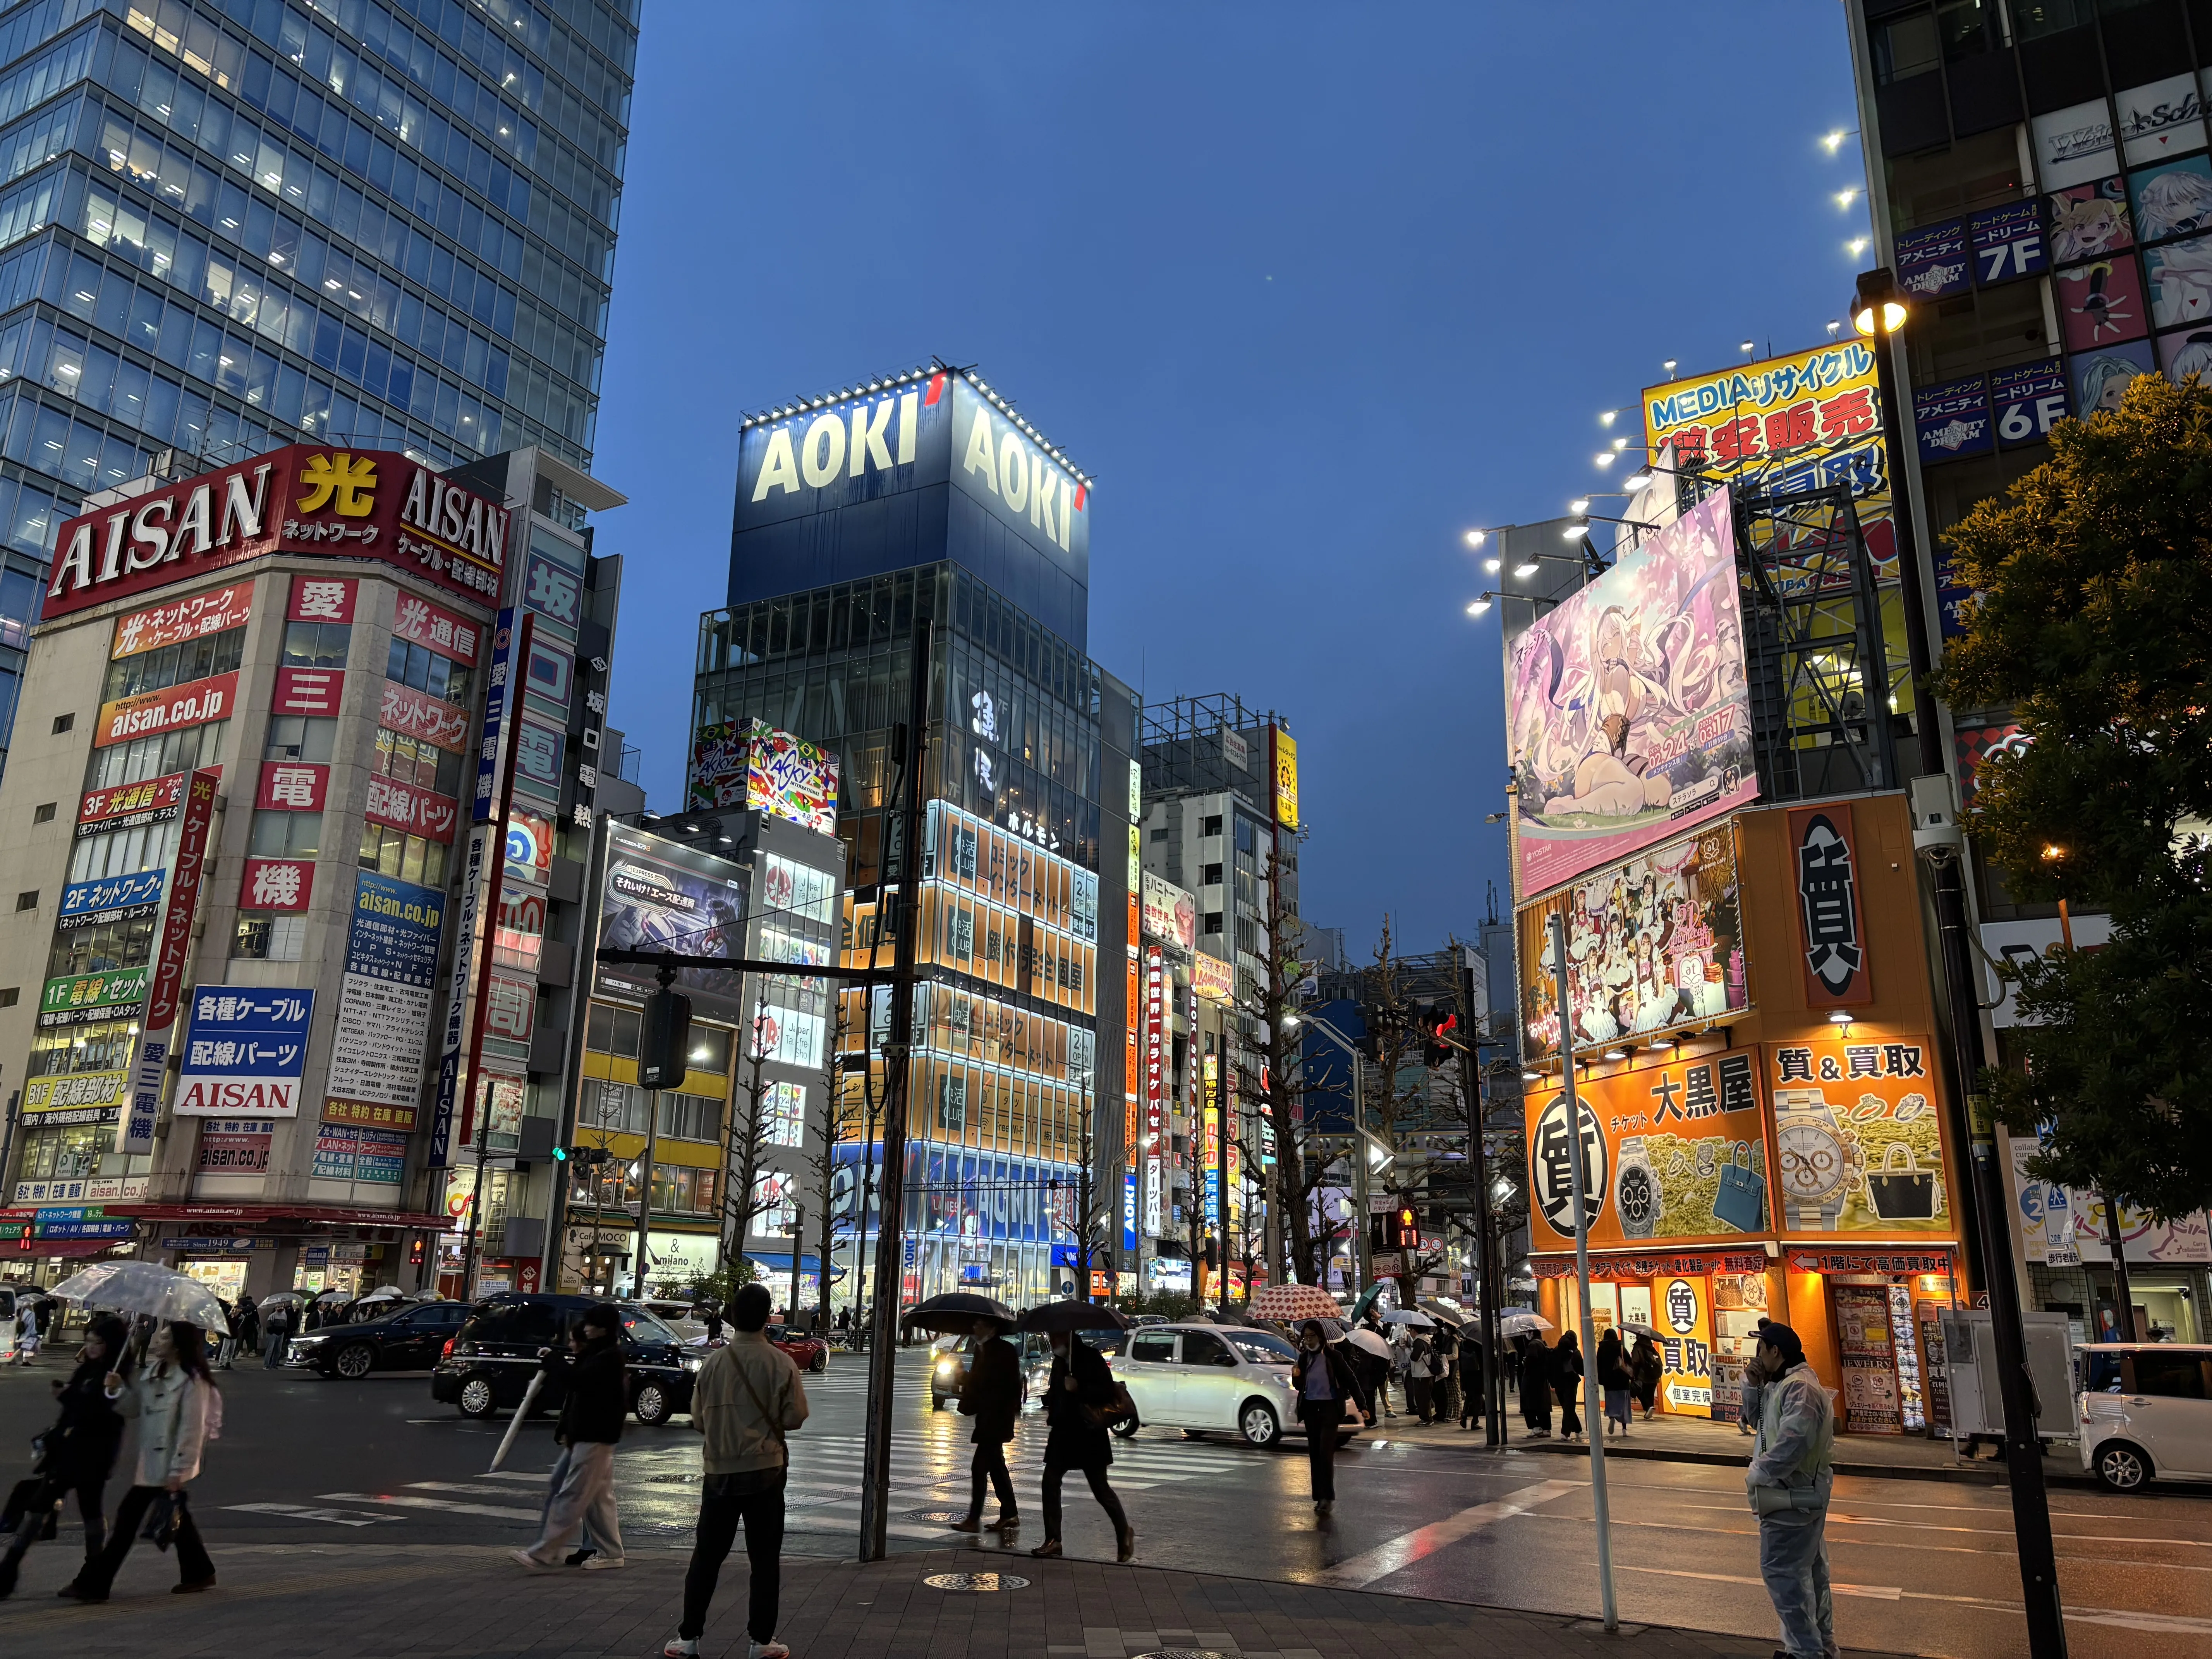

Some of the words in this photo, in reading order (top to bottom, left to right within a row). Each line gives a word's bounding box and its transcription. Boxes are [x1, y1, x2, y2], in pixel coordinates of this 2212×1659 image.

[1898, 225, 1961, 250] トレーディング
[1971, 208, 2030, 230] カードゲーム
[1898, 240, 1963, 266] アメニティ
[1979, 236, 2040, 281] 7F
[1904, 263, 1966, 286] AMENITY
[1911, 272, 1960, 292] DREAM
[1650, 342, 1875, 430] MEDIAリサイクル
[1917, 380, 1983, 403] トレーディング
[1992, 365, 2054, 386] カードゲーム
[1917, 396, 1984, 420] アメニティ
[1999, 394, 2065, 440] 6F
[1922, 419, 1986, 441] AMENITY
[1930, 429, 1980, 448] DREAM
[751, 391, 918, 503] AOKI
[295, 452, 378, 517] 光
[963, 405, 1071, 553] AOKI
[401, 468, 508, 566] AISAN
[47, 462, 271, 598] AISAN
[282, 519, 379, 544] ネットワーク
[398, 534, 500, 598] ケーブル・配線部材
[299, 582, 345, 619] 愛
[528, 563, 578, 622] 坂
[115, 613, 146, 658] 光
[394, 598, 476, 658] 光通信
[110, 689, 223, 737] aisan.co.jp
[115, 693, 162, 711] http://www.
[380, 688, 467, 744] ネットワーク
[1699, 705, 1736, 744] 03.17
[1699, 720, 1712, 729] 2026
[476, 661, 507, 799] 愛三電機
[574, 689, 605, 830] 坂口電熱
[1648, 733, 1687, 769] 02.24
[1649, 745, 1661, 755] 2026
[790, 780, 820, 797] INTERNATIONAL
[948, 780, 960, 798] 7F
[1673, 788, 1697, 804] ステラソラ
[84, 795, 105, 816] 3F
[366, 782, 454, 833] 配線パーツ
[1008, 812, 1060, 850] ホルモン
[1130, 814, 1139, 825] 8F
[1532, 843, 1552, 859] YOSTAR
[1707, 841, 1716, 852] at
[991, 845, 1029, 875] コミック
[1717, 856, 1726, 865] cafe
[632, 867, 654, 879] EXPRESS
[65, 888, 87, 910] 2F
[153, 779, 212, 1017] 光・ケーブル・ネットワーク
[361, 879, 397, 895] http://www.
[1151, 878, 1175, 897] ハニトー
[359, 890, 439, 929] aisan.co.jp
[1145, 903, 1175, 925] 曲数世界一
[1158, 897, 1162, 907] &
[1799, 836, 1861, 975] 質
[356, 918, 437, 943] 光通信部材・光ファイバー
[447, 838, 482, 1045] 各種ケーブル・ネットワーク機器
[1144, 917, 1175, 941] カラオケ
[1222, 965, 1231, 979] DVD
[1685, 965, 1696, 976] at
[48, 984, 67, 1005] 1F
[198, 996, 306, 1022] 各種ケーブル
[189, 1041, 298, 1067] 配線パーツ
[1778, 1045, 1925, 1082] 質&買取
[27, 1084, 50, 1106] B1F
[129, 1042, 165, 1140] 愛三電機
[181, 1082, 292, 1109] AISAN
[1651, 1053, 1755, 1126] 大黒屋
[328, 1101, 348, 1117] 各社
[351, 1104, 370, 1119] 特約
[373, 1106, 391, 1122] 在庫
[395, 1109, 412, 1124] 直販
[433, 1060, 454, 1155] AISAN
[206, 1121, 220, 1132] 各社
[225, 1122, 239, 1132] 特約
[243, 1121, 257, 1132] 在庫
[1611, 1111, 1648, 1133] チケット
[1206, 1123, 1217, 1166] DVD
[317, 1165, 351, 1177] 配線材料
[1540, 1109, 1602, 1221] 質
[17, 1184, 30, 1199] 各社
[33, 1183, 45, 1199] 特約
[52, 1183, 66, 1199] 在庫
[68, 1183, 81, 1197] 直販
[978, 1174, 1034, 1225] AOKI
[1149, 1164, 1158, 1226] ダーツバー
[357, 1212, 400, 1221] www.aisan.co.jp
[1125, 1185, 1135, 1233] AOKI
[208, 1239, 229, 1247] 1949
[598, 1233, 627, 1242] MOCO
[670, 1238, 679, 1253] &
[659, 1254, 688, 1266] milano
[905, 1240, 915, 1269] AOKI
[1532, 1262, 1560, 1277] 高価買取
[1724, 1254, 1762, 1272] 無料査定
[1820, 1255, 1949, 1271] 1階にて高価買取中
[1668, 1287, 1692, 1328] 質
[1977, 1296, 1989, 1310] 4
[1628, 1313, 1647, 1323] 大黒屋
[1663, 1337, 1711, 1377] 買取
[1843, 1359, 1892, 1369] JEWELRY
[1673, 1389, 1712, 1403] 個室完備
[1711, 1403, 1739, 1413] Currency
